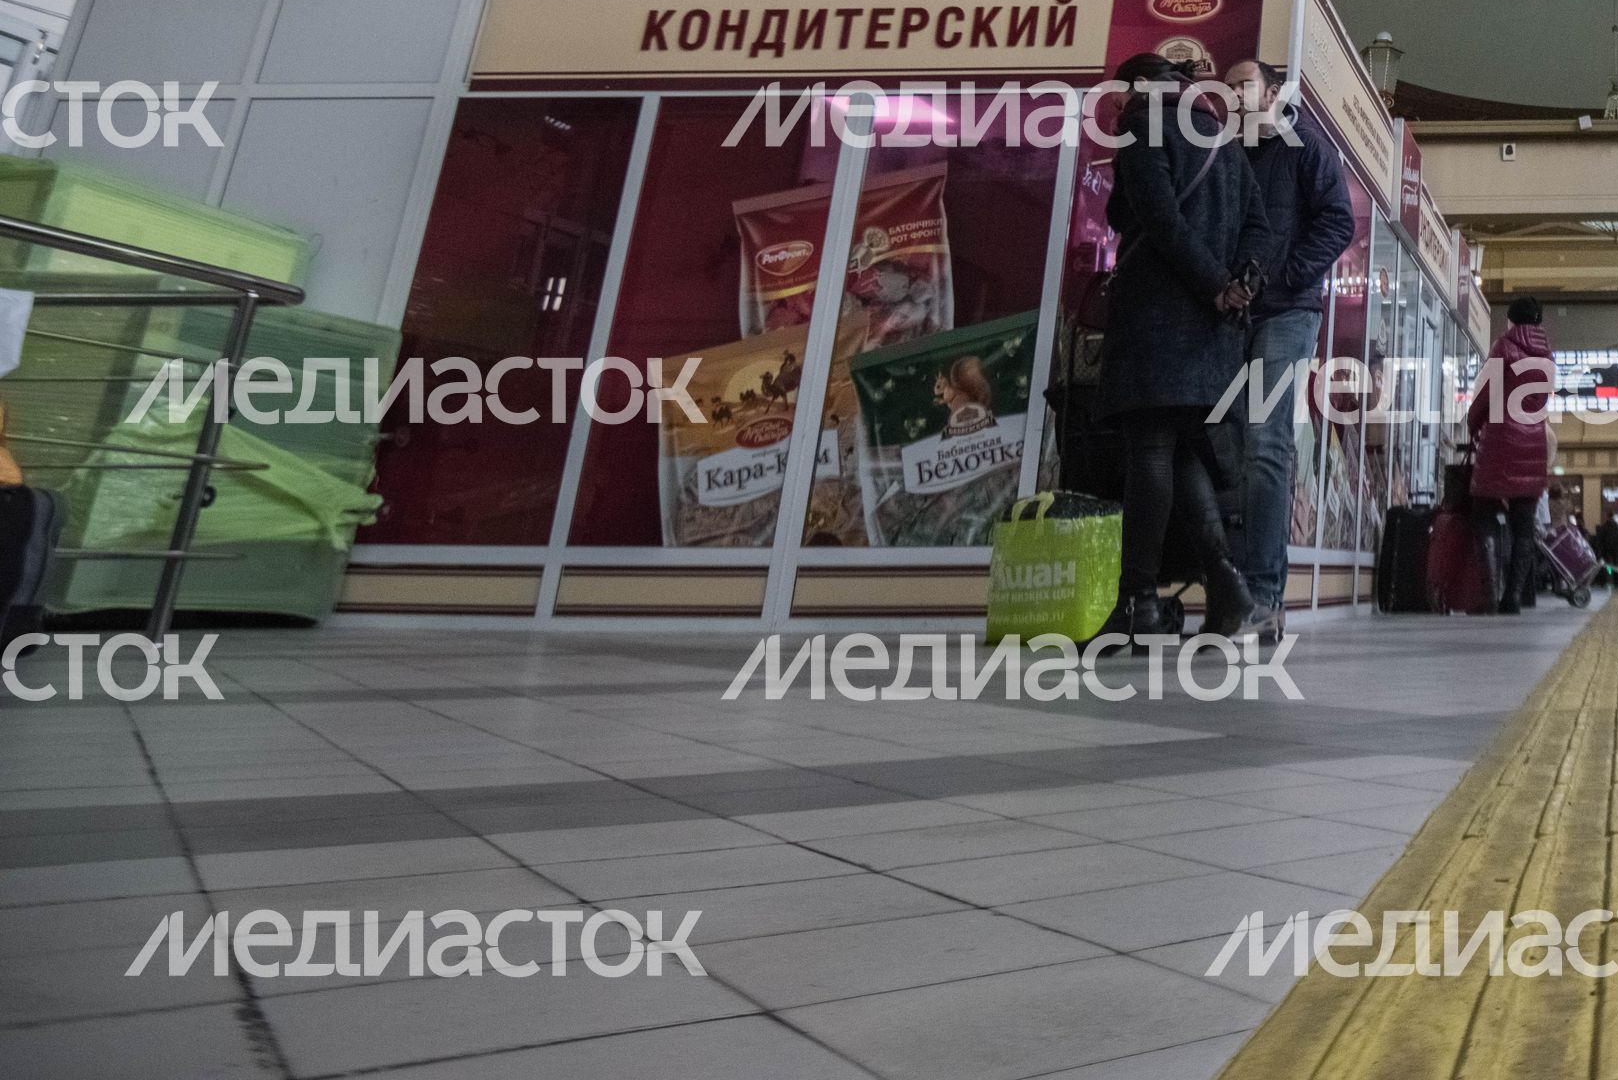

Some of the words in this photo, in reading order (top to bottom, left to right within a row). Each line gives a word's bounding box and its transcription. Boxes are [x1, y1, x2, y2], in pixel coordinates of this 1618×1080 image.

[706, 446, 830, 491] Кара-Км
[916, 440, 1024, 485] Белочка
[937, 435, 1002, 461] Бабаевская
